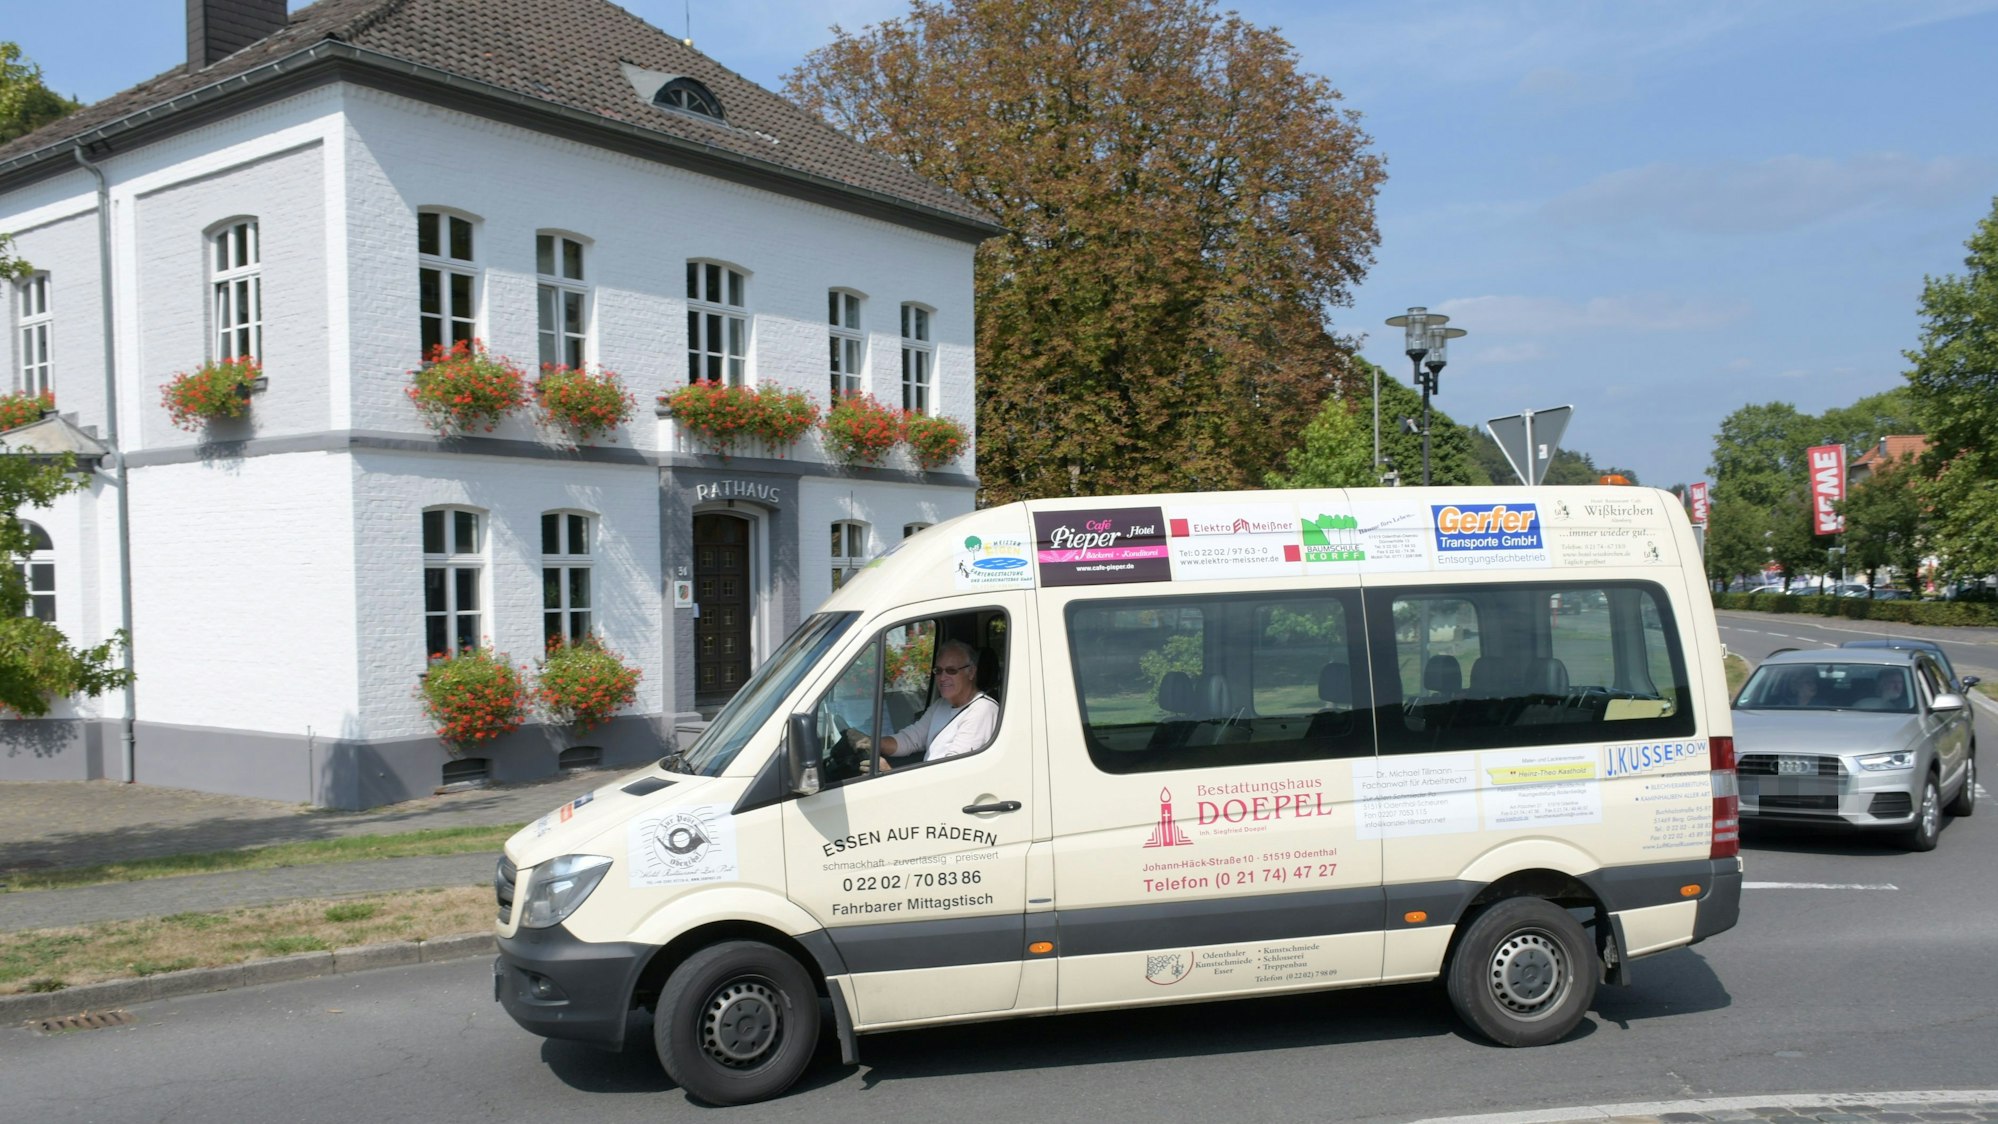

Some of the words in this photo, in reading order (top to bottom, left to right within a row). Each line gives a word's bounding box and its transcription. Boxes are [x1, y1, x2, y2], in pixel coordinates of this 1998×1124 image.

[696, 479, 781, 503] RATHAUS
[1584, 504, 1654, 519] Wißkirchen
[1085, 519, 1112, 533] Café
[1193, 523, 1231, 533] Elektro
[1252, 521, 1293, 532] Meißner
[1438, 506, 1536, 534] Gerfer
[1126, 524, 1155, 538] Hotel
[1600, 527, 1630, 537] wieder
[1050, 524, 1121, 560] Pieper
[1306, 544, 1361, 553] BAUMSCHULE
[1440, 537, 1499, 549] Transporte
[1501, 535, 1537, 547] GmbH
[1179, 555, 1280, 567] www.elektro-meissner.de
[1308, 551, 1361, 561] KORFF
[1438, 552, 1546, 566] Entsorgungsfachbetrieb
[1076, 563, 1135, 572] www.cafe-pieper.de
[1376, 770, 1388, 779] Dr.
[1389, 768, 1420, 778] Michael
[1422, 767, 1453, 776] Tillmann
[1518, 769, 1556, 779] Heinz-Theo
[1197, 778, 1322, 797] Bestattungshaus
[1362, 780, 1408, 790] Fachanwalt
[1409, 778, 1419, 787] für
[1420, 776, 1467, 786] Arbeitsrecht
[1197, 792, 1333, 826] DOEPEL
[1213, 827, 1242, 837] Siegfried
[1244, 825, 1267, 835] Doepel
[822, 829, 881, 858] ESSEN
[887, 826, 920, 842] AUF
[925, 822, 998, 847] RÄDERN
[823, 859, 885, 872] schmackhaft
[893, 854, 947, 867] zuverlässig
[955, 850, 1000, 864] preiswert
[1143, 854, 1241, 872] Johann-Häck-Straße
[1242, 854, 1254, 864] 10
[1263, 850, 1291, 861] 51519
[1293, 847, 1337, 859] Odenthal
[843, 877, 853, 892] 0
[856, 876, 877, 891] 22
[880, 874, 901, 889] 02
[913, 872, 934, 888] 70
[937, 871, 957, 886] 83
[961, 869, 981, 884] 86
[1144, 874, 1208, 892] Telefon
[1236, 870, 1255, 885] 21
[1262, 867, 1287, 884] 74)
[1293, 865, 1312, 879] 47
[1318, 863, 1338, 877] 27
[832, 900, 903, 916] Fahrbarer
[907, 892, 994, 911] Mittagstisch
[1202, 950, 1246, 960] Odenthaler
[1263, 943, 1320, 954] Kunstschmiede
[1195, 957, 1253, 969] Kunstschmiede
[1263, 953, 1304, 963] Schlosserei
[1213, 966, 1234, 975] Esser
[1262, 961, 1308, 971] Treppenbau
[1255, 974, 1283, 983] Telefon
